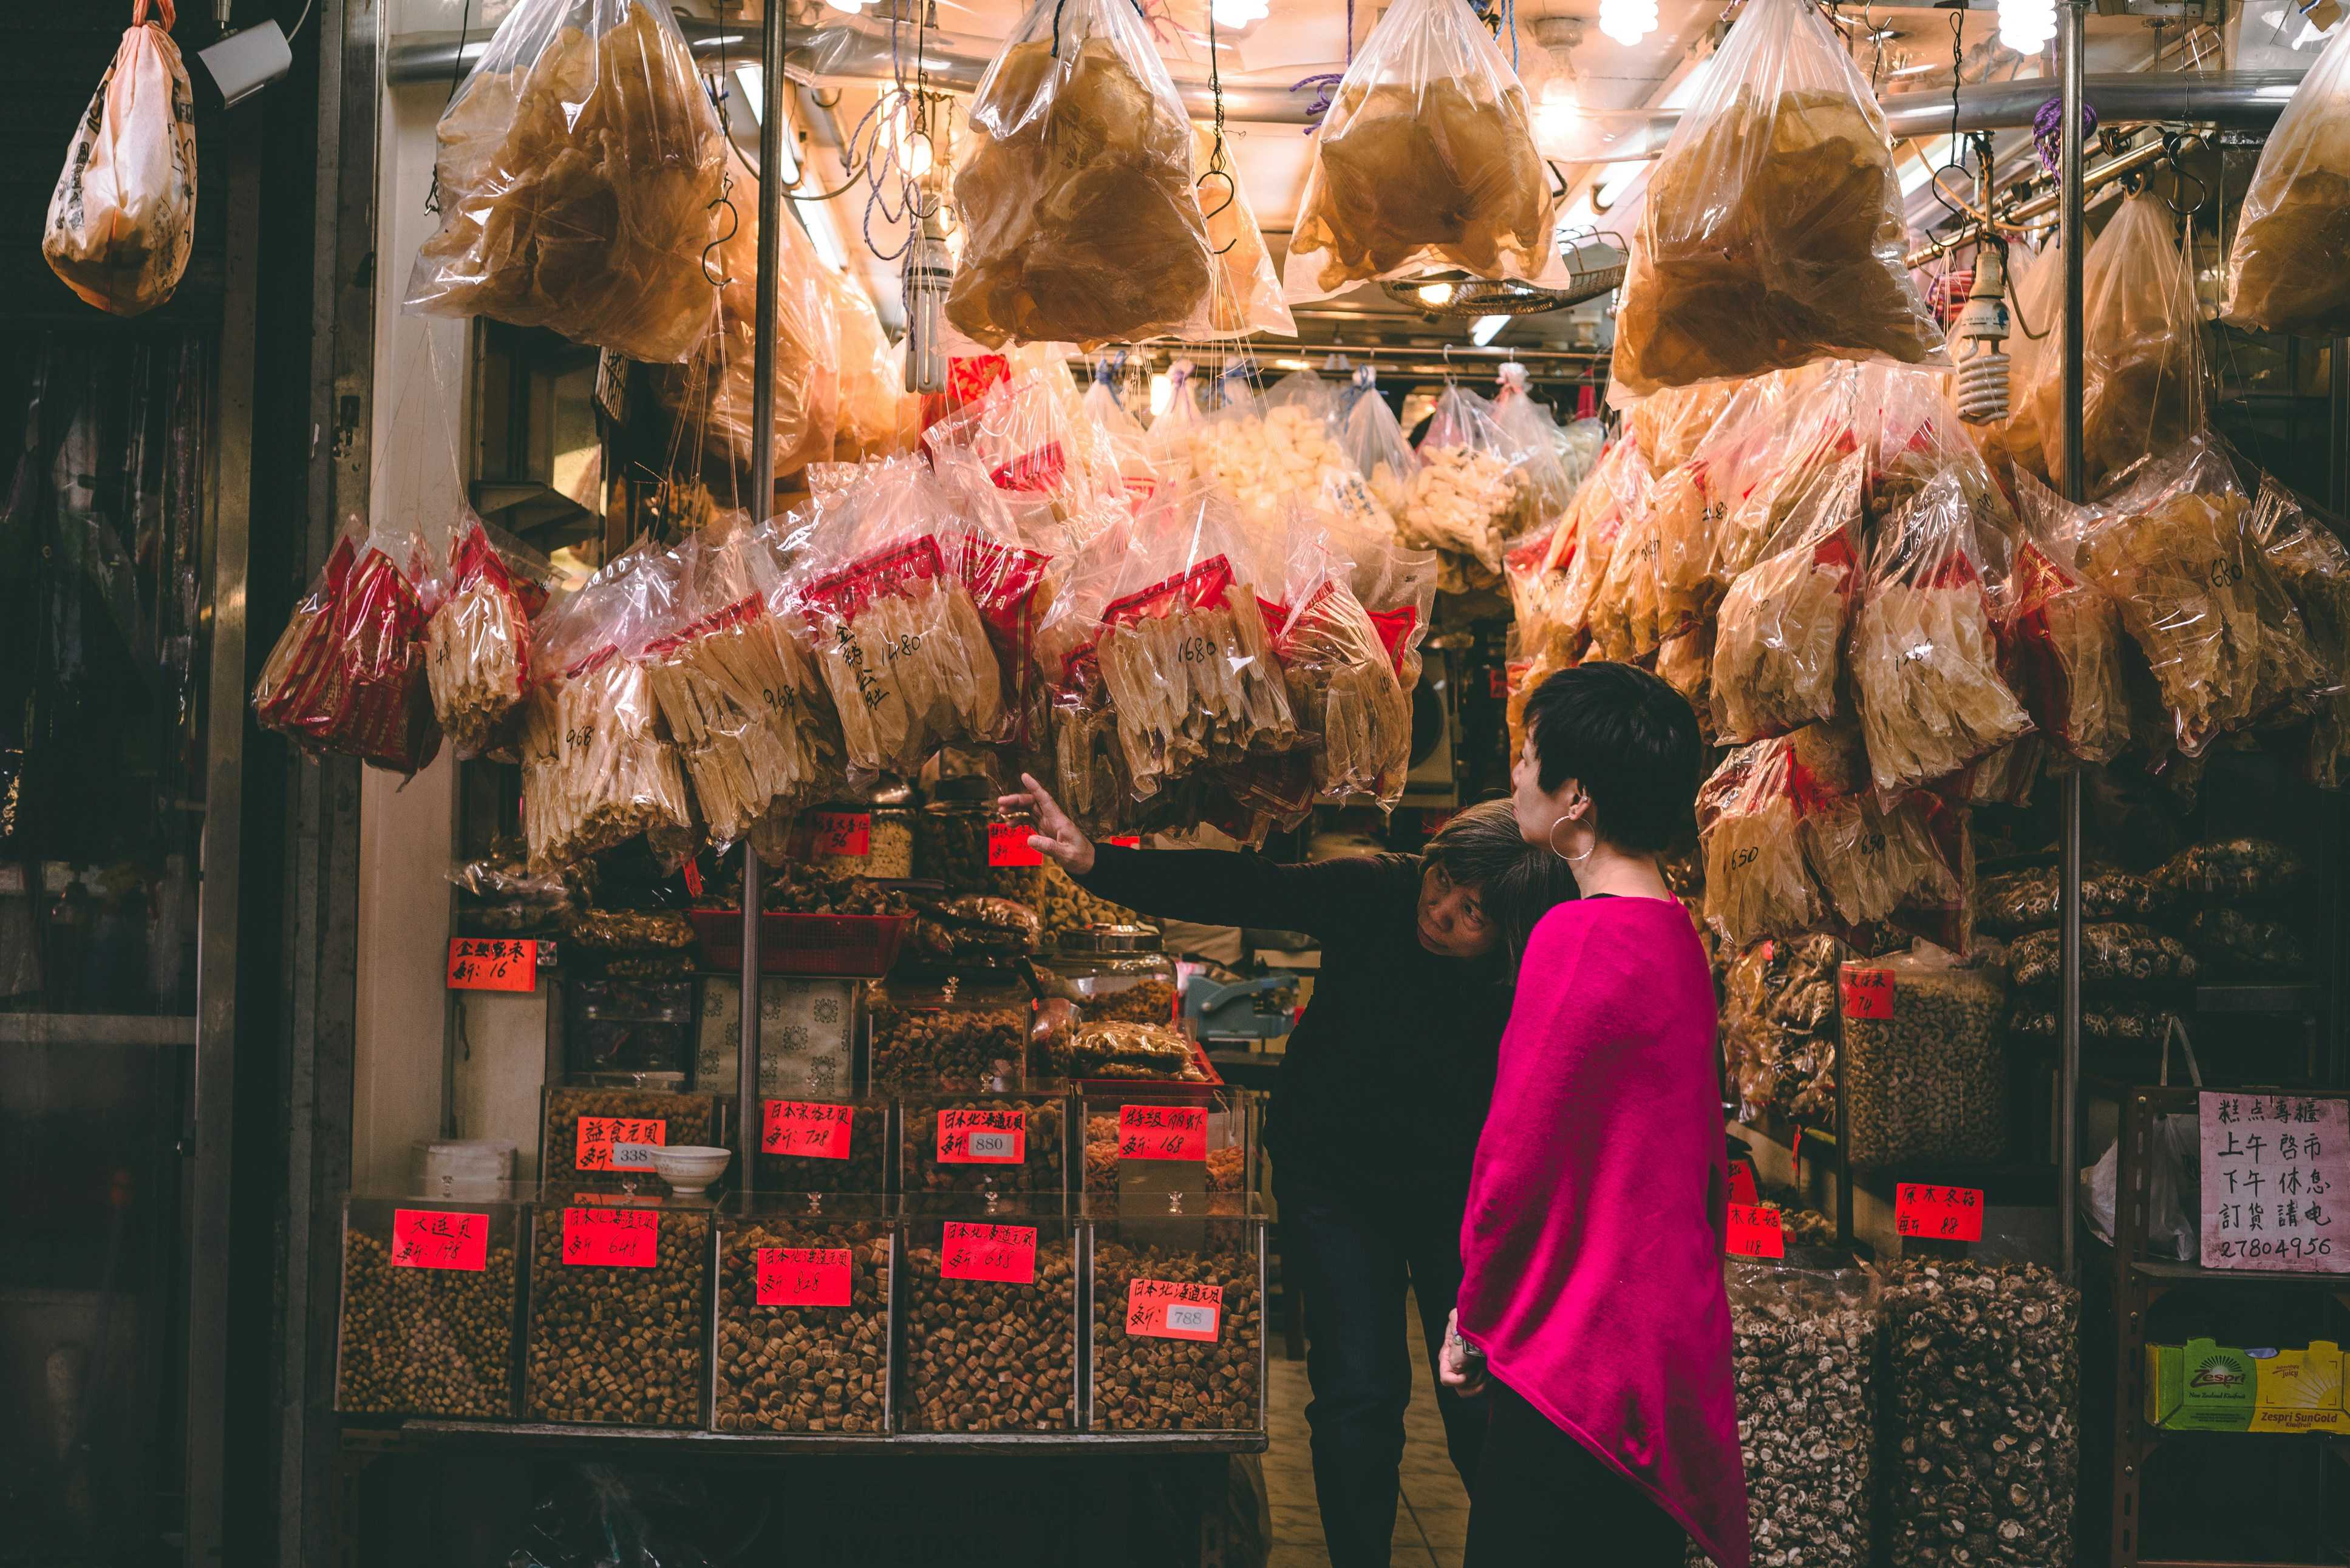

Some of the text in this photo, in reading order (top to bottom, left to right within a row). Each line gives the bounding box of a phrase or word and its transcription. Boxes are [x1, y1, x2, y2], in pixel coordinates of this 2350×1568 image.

[2211, 558, 2243, 588] 680
[882, 634, 921, 667] 1480
[1178, 636, 1216, 664] 1680
[763, 685, 794, 715] 968
[567, 725, 595, 750] 968
[831, 832, 848, 848] 56
[490, 961, 508, 978] 16
[806, 1130, 829, 1147] 728
[976, 1138, 1003, 1150] 880
[1160, 1135, 1185, 1153] 168
[621, 1149, 648, 1162] 338
[1941, 1217, 1958, 1234] 88
[436, 1241, 463, 1260] 198
[609, 1234, 640, 1257] 648
[1746, 1239, 1762, 1255] 118
[2220, 1237, 2332, 1258] 27804956
[984, 1247, 1015, 1269] 688
[794, 1270, 820, 1294] 828
[1174, 1311, 1202, 1325] 788
[2190, 1369, 2246, 1388] Zespri
[2261, 1411, 2338, 1424] Zespri SunGold
